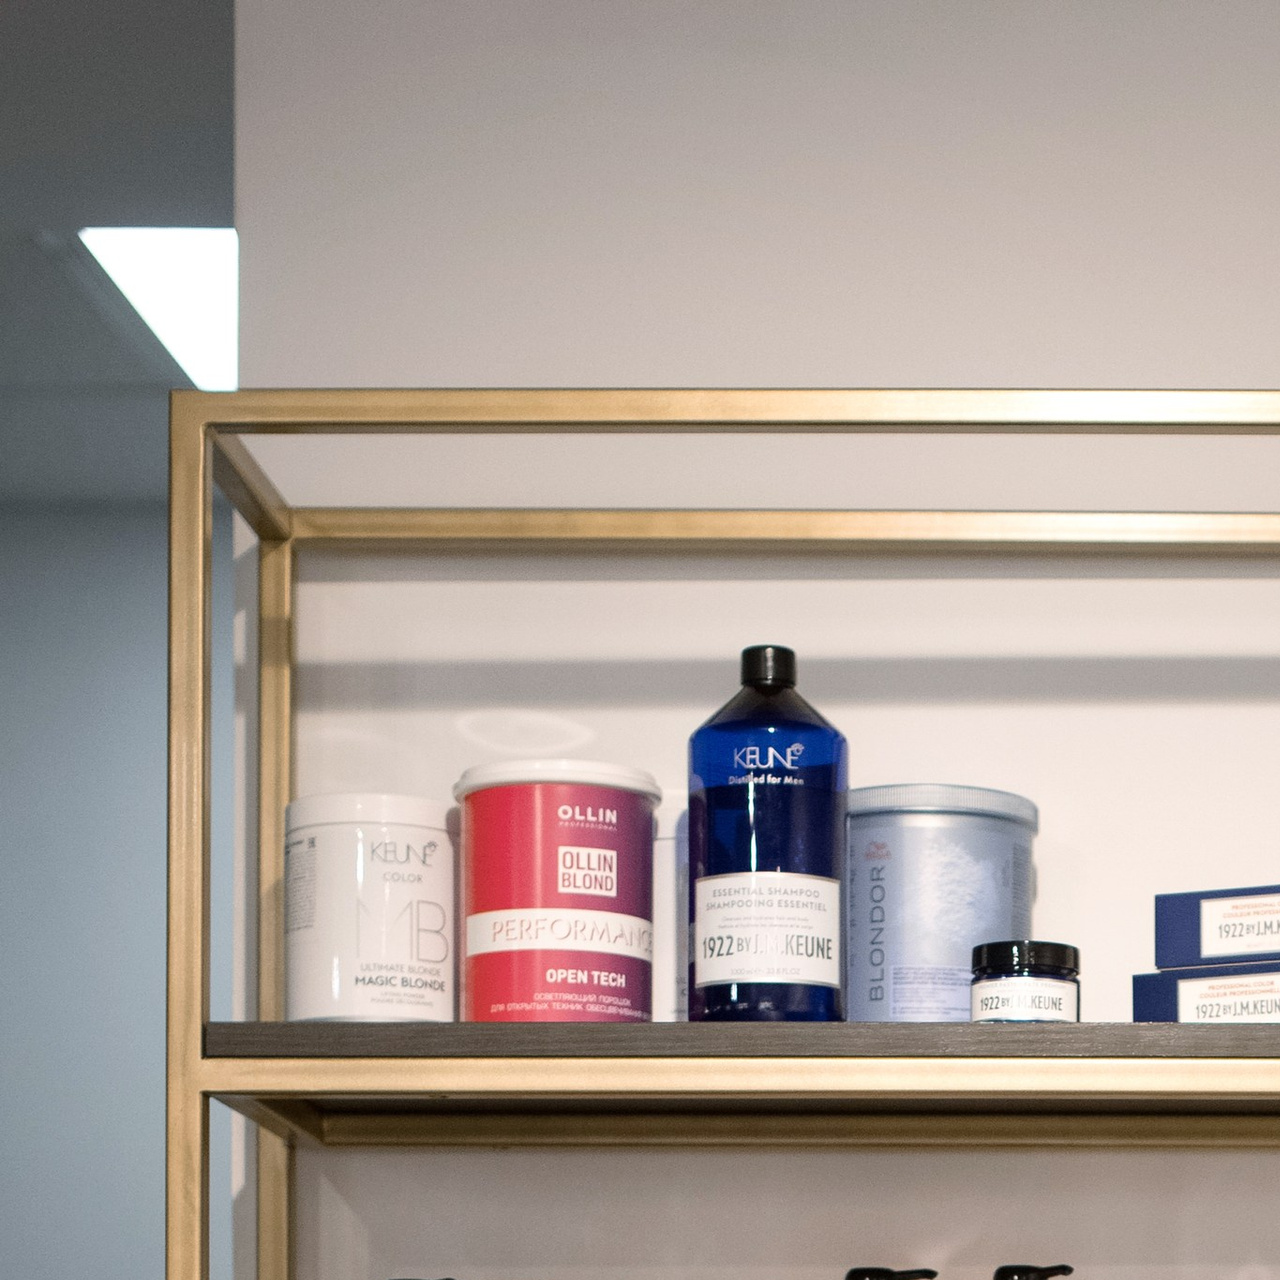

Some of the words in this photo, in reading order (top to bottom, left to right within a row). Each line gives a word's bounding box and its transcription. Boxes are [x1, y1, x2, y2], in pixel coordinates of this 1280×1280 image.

[734, 744, 804, 769] KEUNE
[767, 774, 782, 784] for
[783, 775, 804, 785] Men
[557, 805, 617, 824] OLLIN
[370, 841, 438, 867] KEUNE
[562, 851, 613, 873] OLLIN
[383, 871, 423, 883] COLOR
[561, 873, 614, 892] BLOND
[712, 887, 764, 898] ESSENTIAL
[767, 887, 820, 898] SHAMPOO
[706, 899, 774, 911] SHAMPOOING
[777, 900, 827, 912] ESSENTIEL
[492, 918, 652, 952] PERFORMANC
[869, 865, 886, 1001] BLONDOR
[1218, 922, 1245, 939] 1922
[1246, 924, 1255, 935] BY
[702, 935, 735, 960] 1922
[737, 937, 751, 952] BY
[360, 962, 404, 973] ULTIMATE
[408, 964, 441, 977] BLONDE
[546, 969, 588, 984] OPEN
[591, 971, 626, 988] TECH
[355, 976, 397, 987] MAGIC
[401, 976, 445, 991] BLONDE
[980, 996, 1000, 1011] 1922
[1196, 1003, 1222, 1020] 1922
